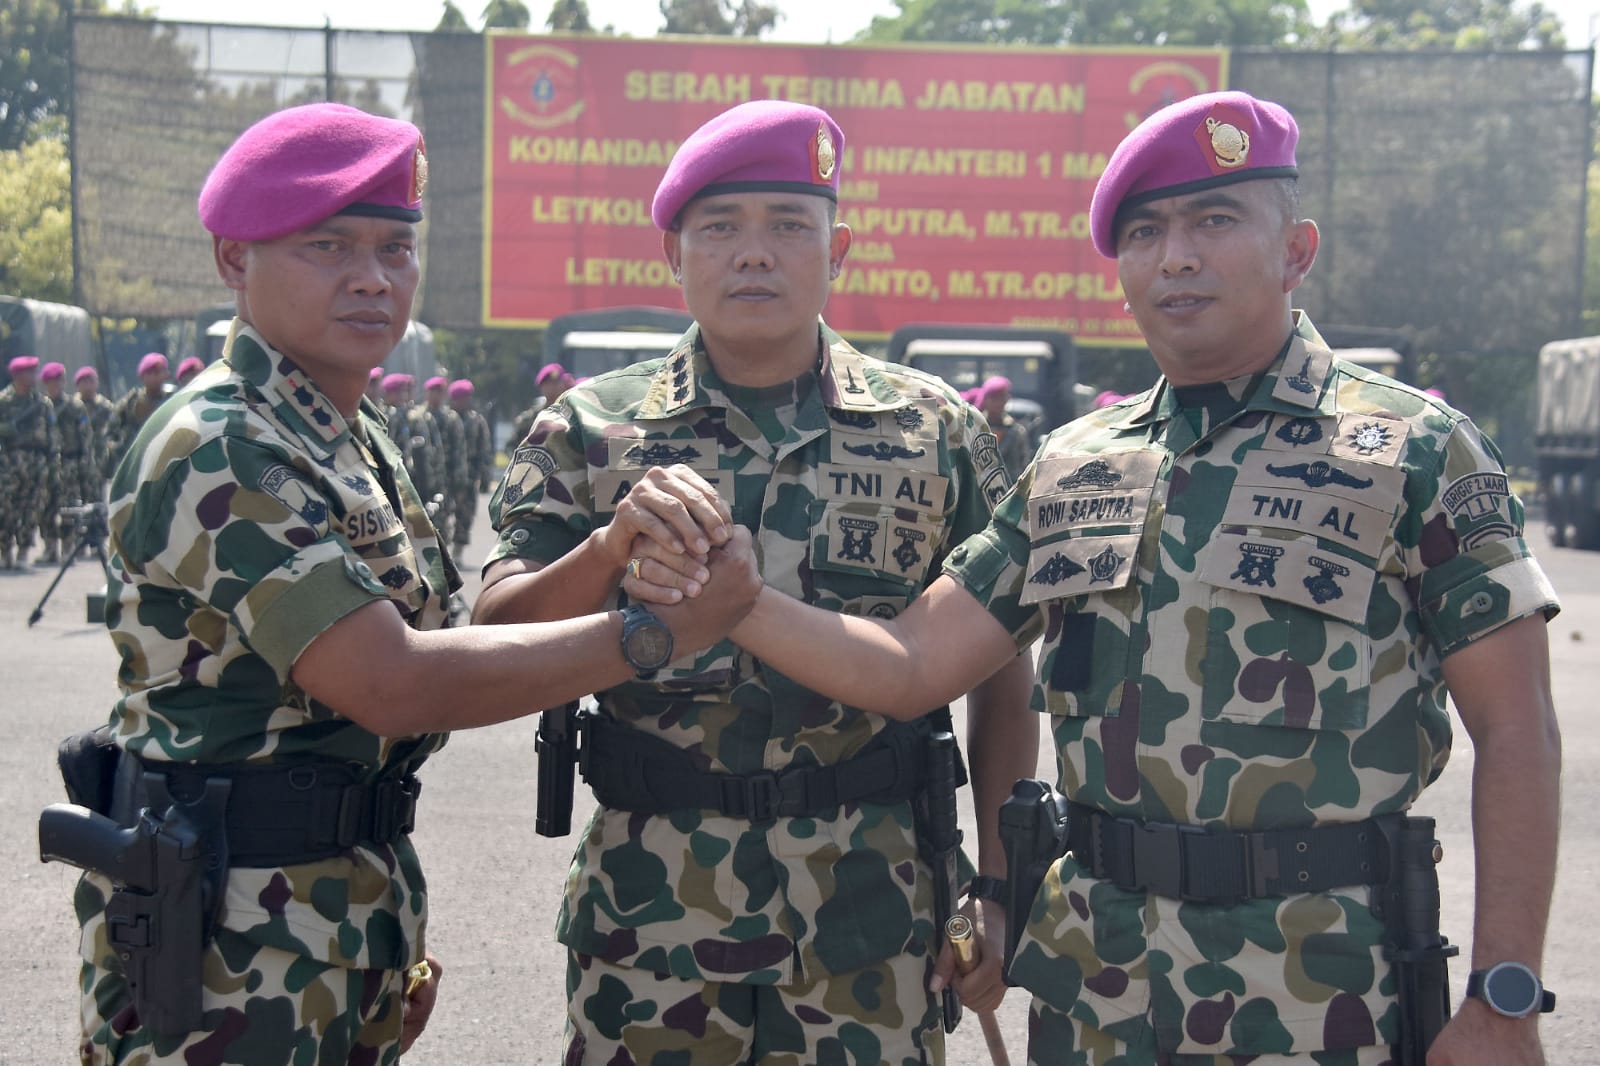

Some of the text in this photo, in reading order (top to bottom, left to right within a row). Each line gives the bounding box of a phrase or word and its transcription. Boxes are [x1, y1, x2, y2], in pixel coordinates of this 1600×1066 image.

[625, 71, 1085, 113] SERAH TERIMA JABATAN
[863, 147, 1027, 178] INFANTERI
[1036, 152, 1052, 178] 1
[838, 180, 880, 200] ARI
[532, 196, 1090, 241] LETKOL APUTRA, M.TR.O
[850, 241, 896, 262] ADA
[828, 471, 933, 508] TNI AL
[1445, 480, 1473, 509] BRIGIF
[1483, 476, 1505, 491] MAR
[1475, 496, 1487, 513] 1
[1038, 496, 1134, 529] RONI SAPUTRA
[1251, 494, 1360, 541] TNI AL
